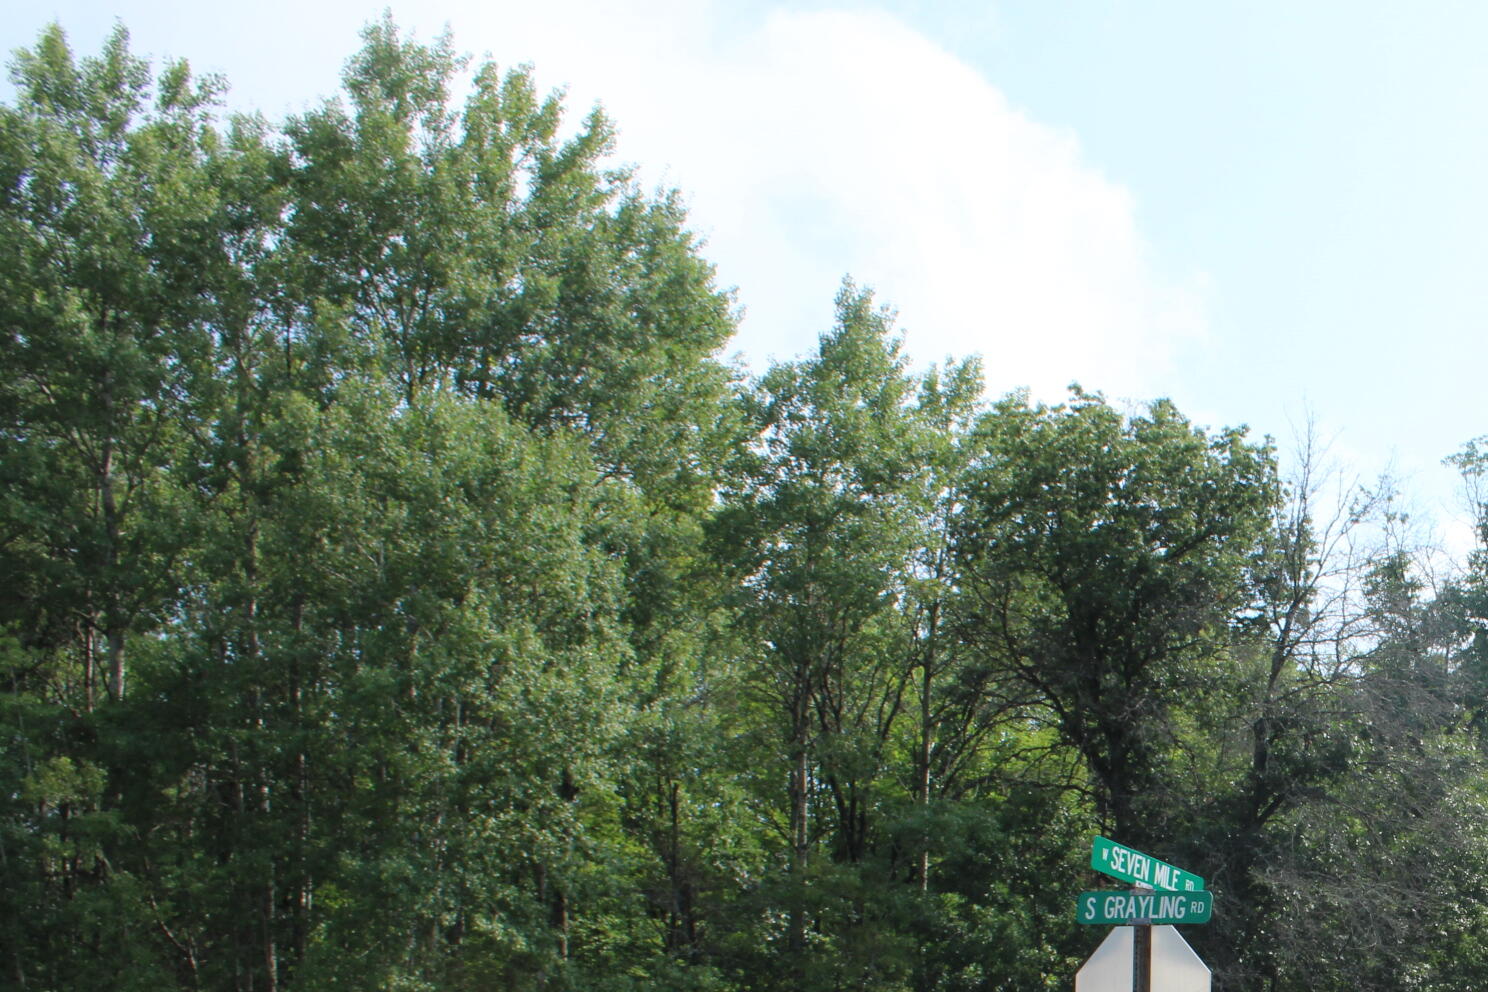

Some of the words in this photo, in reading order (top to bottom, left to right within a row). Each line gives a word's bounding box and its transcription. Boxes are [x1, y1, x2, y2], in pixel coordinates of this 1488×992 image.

[1102, 847, 1109, 861] W
[1110, 846, 1150, 881] SEVEN
[1154, 862, 1181, 891] MILE
[1184, 879, 1195, 892] RD
[1085, 897, 1096, 920] S
[1104, 896, 1186, 919] GRAYLING
[1190, 901, 1205, 914] RD
